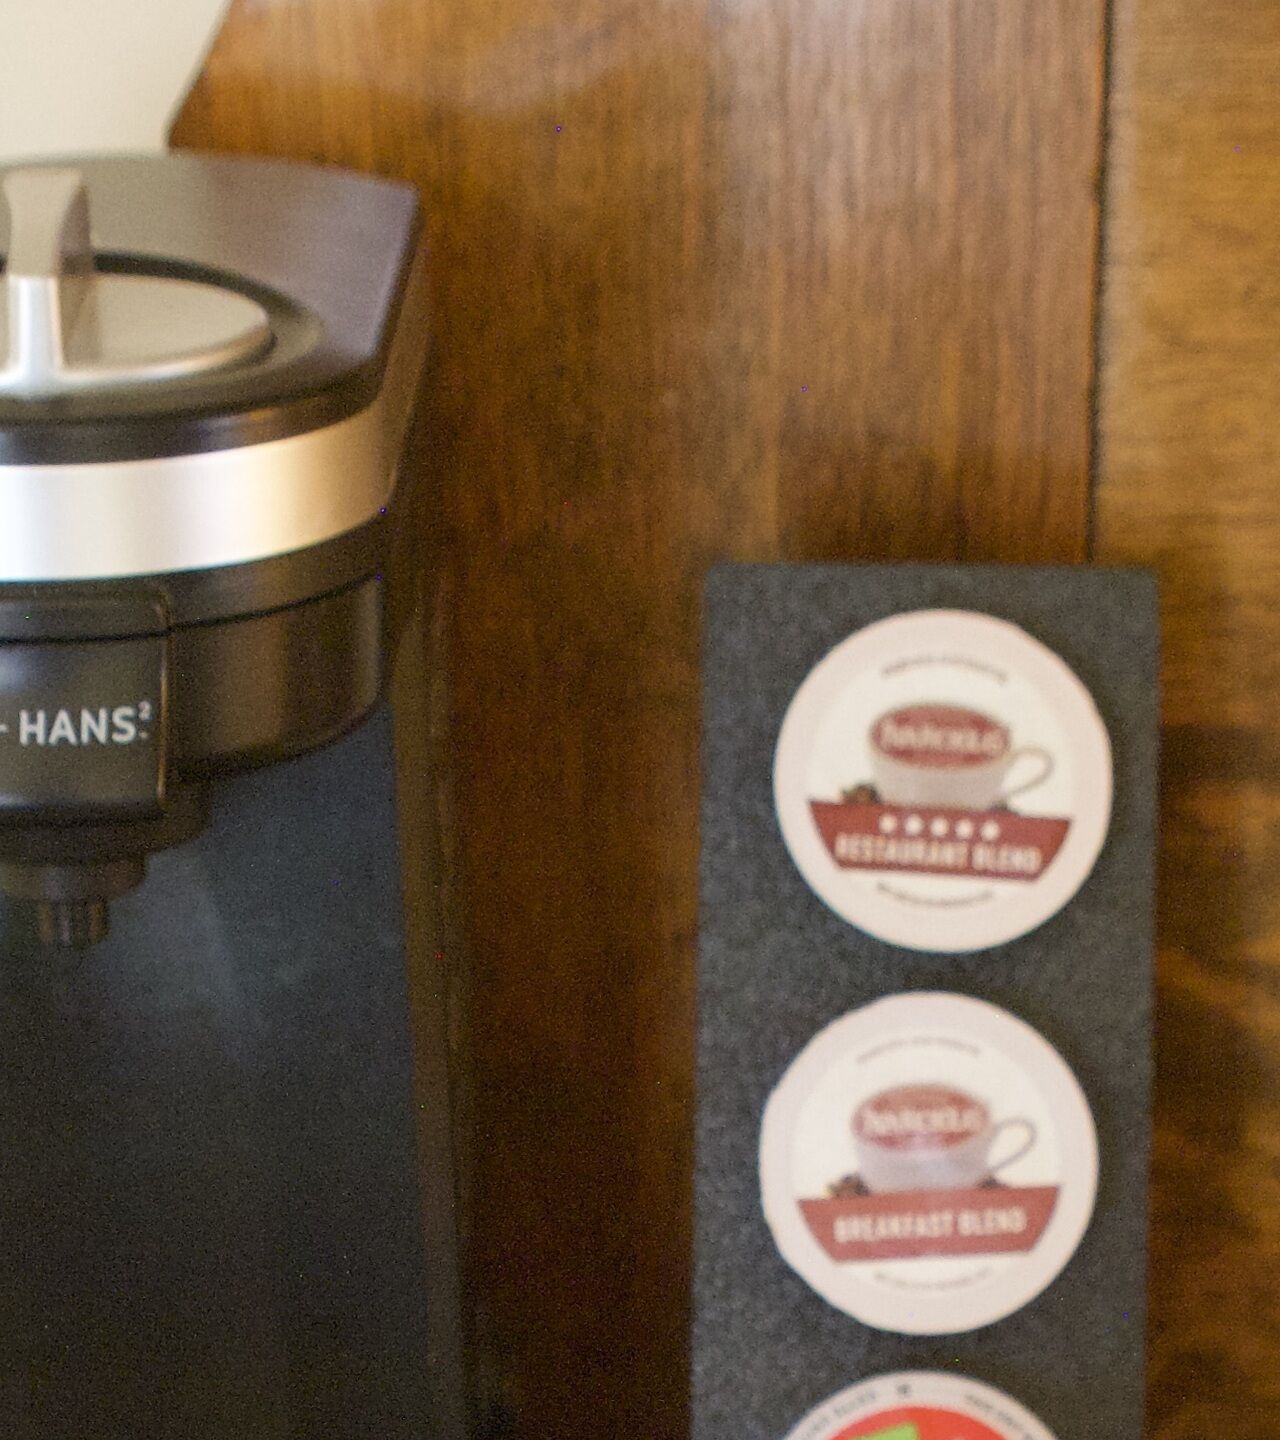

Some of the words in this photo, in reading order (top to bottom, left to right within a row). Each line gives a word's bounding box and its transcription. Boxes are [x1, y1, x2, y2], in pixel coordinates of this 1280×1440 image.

[972, 841, 1043, 872] BLEND
[832, 1210, 954, 1244] BREAKFAST
[956, 1206, 1028, 1237] BLEND
